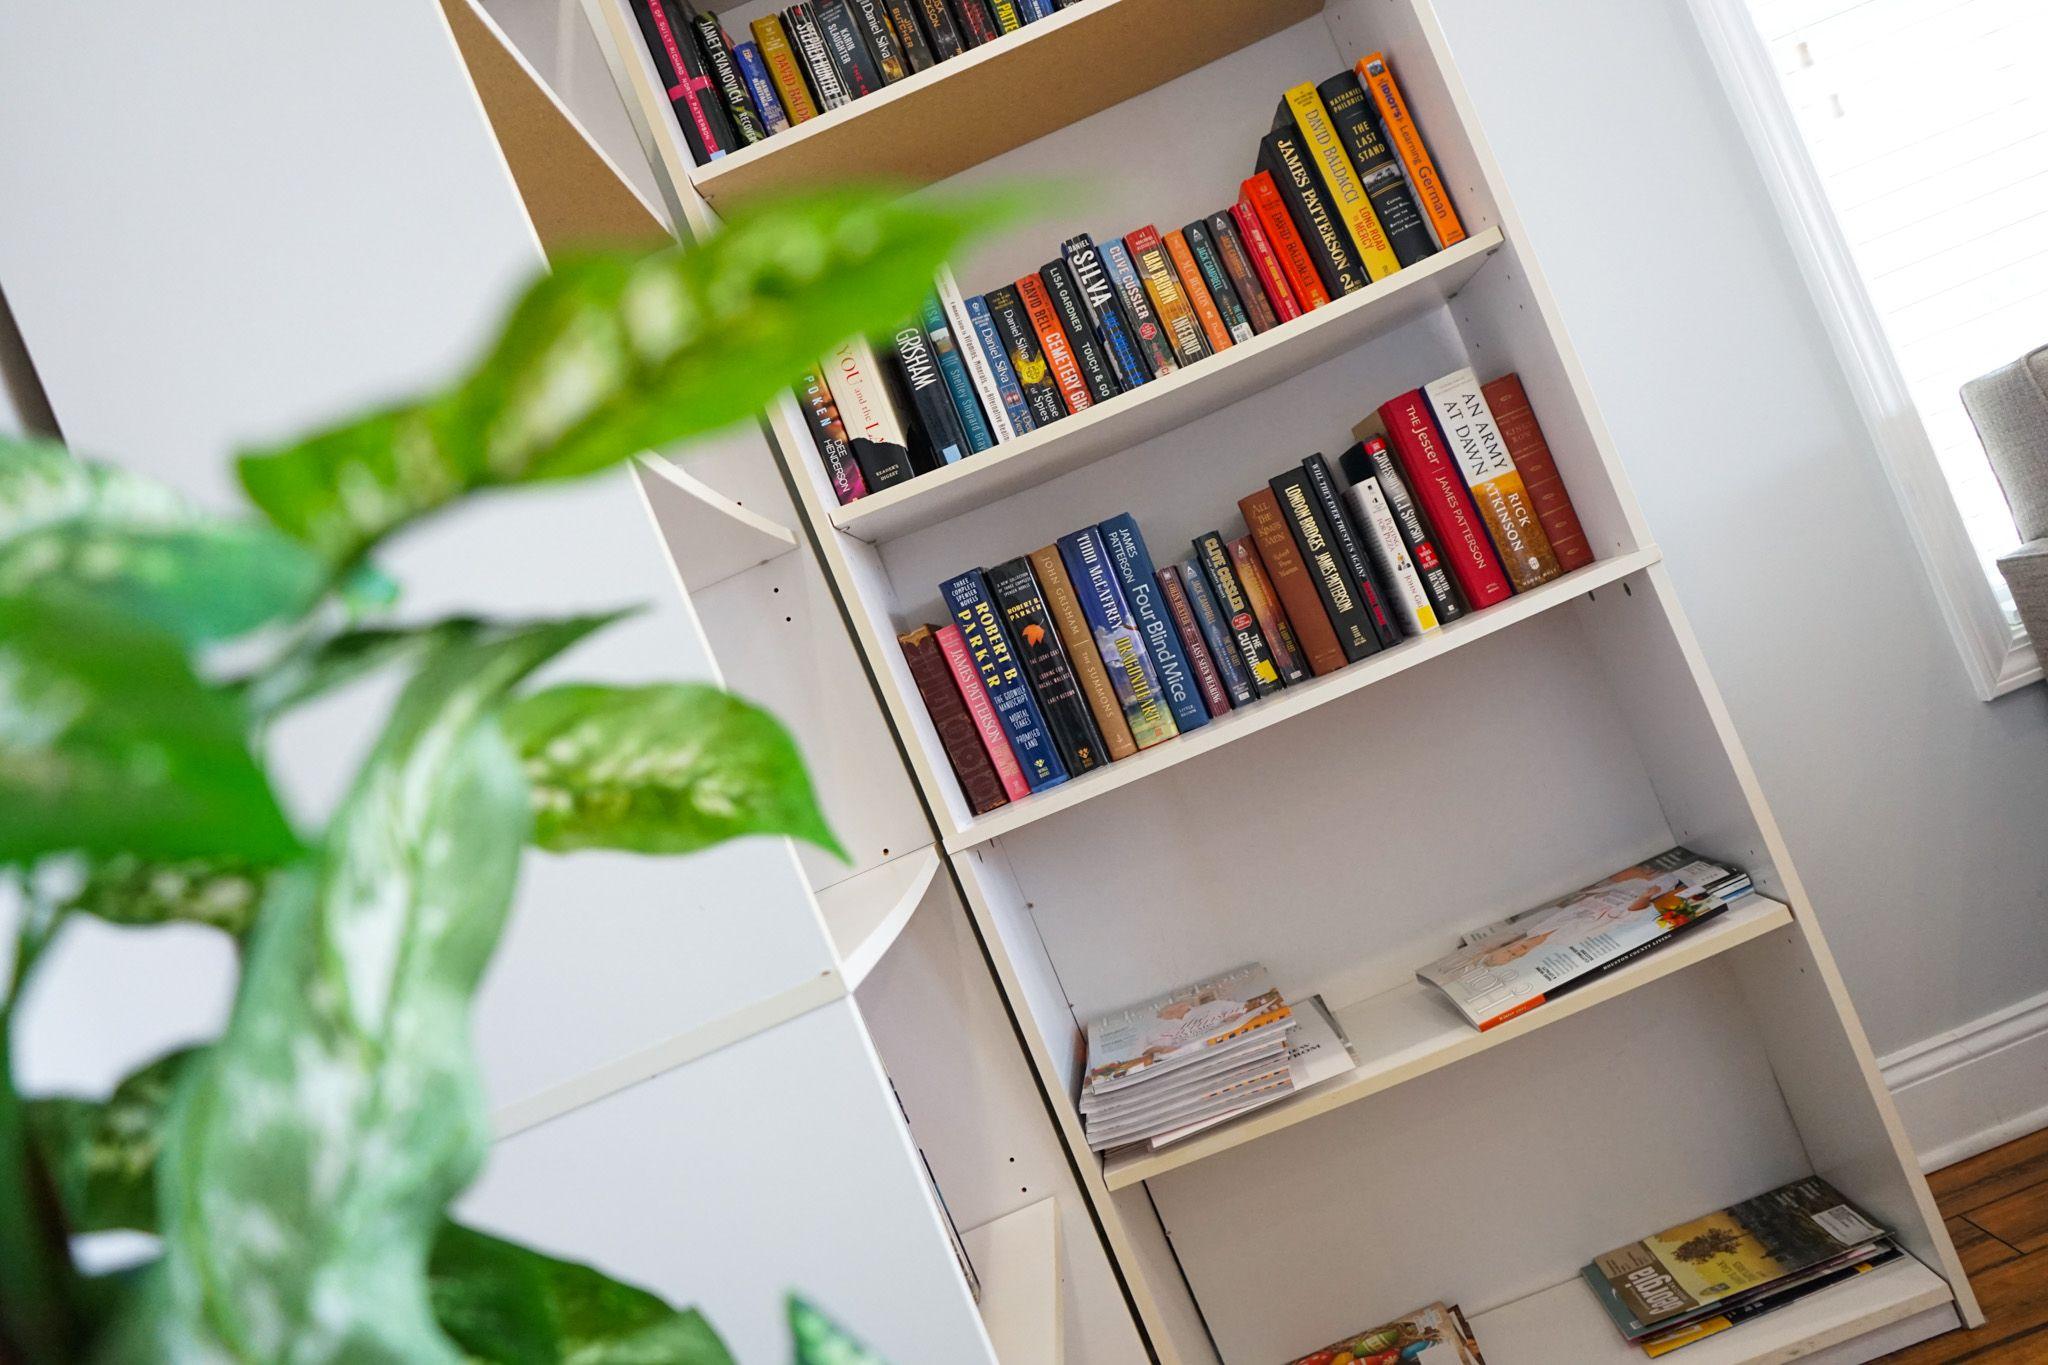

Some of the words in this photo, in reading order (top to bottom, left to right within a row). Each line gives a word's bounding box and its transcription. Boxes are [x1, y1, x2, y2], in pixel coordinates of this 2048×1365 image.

[861, 3, 882, 34] Daniel
[875, 35, 892, 58] Silva
[891, 7, 913, 48] BUTCHER
[903, 17, 914, 33] JIM
[996, 2, 1019, 32] PATTE
[796, 19, 828, 63] STEPHEN
[812, 59, 840, 97] HUNTER
[827, 23, 850, 64] SLAUGHTER
[840, 28, 854, 50] KARIN
[699, 19, 721, 50] JANET
[712, 51, 743, 104] EVANOVICH
[668, 46, 684, 75] RICHARD
[681, 77, 694, 99] NORTH
[690, 102, 710, 140] PATTERSON
[773, 51, 796, 86] DAVID
[789, 88, 812, 122] BALDA
[1352, 121, 1369, 134] THE
[1356, 133, 1376, 147] LAST
[1305, 109, 1330, 145] DAVID
[1322, 145, 1358, 204] BALDACCI
[1358, 143, 1385, 161] STAND
[1399, 125, 1421, 163] Learning
[1417, 165, 1449, 219] German
[1277, 137, 1309, 188] JAMES
[1303, 188, 1349, 270] PATTERSON
[1067, 239, 1089, 252] DANIEL
[1271, 212, 1290, 240] DAVID
[1287, 241, 1312, 286] BALDACCI
[1353, 221, 1373, 250] MERCY
[1359, 206, 1374, 228] LONG
[1370, 228, 1385, 251] ROAD
[1072, 249, 1112, 307] SILVA
[1142, 250, 1164, 272] DAN
[1197, 245, 1209, 261] JACK
[1204, 260, 1222, 291] CAMPBELL
[1110, 246, 1128, 274] CLIVE
[1122, 275, 1148, 319] CUSSLER
[1152, 270, 1178, 304] BROWN
[1189, 276, 1209, 308] BEATON
[1003, 309, 1020, 337] Daniel
[1016, 337, 1029, 358] Silva
[1022, 281, 1041, 308] DAVID
[1034, 309, 1051, 332] BELL
[1045, 331, 1080, 392] CEMETERY
[1070, 389, 1089, 411] GIR
[1050, 267, 1063, 288] LISA
[1059, 289, 1081, 331] GARDNER
[1081, 342, 1099, 372] TOUCH
[1099, 383, 1109, 396] GO
[1171, 314, 1200, 355] INFERNO
[894, 326, 936, 390] GRISHAM
[982, 328, 1000, 358] Daniel
[995, 360, 1010, 382] Silva
[803, 375, 831, 426] POKEN
[835, 345, 862, 386] YOU
[855, 387, 866, 404] and
[862, 406, 873, 420] the
[950, 368, 967, 398] Shelley
[961, 399, 980, 431] Shepard
[1042, 387, 1059, 417] House
[1034, 395, 1050, 421] Spies
[834, 439, 846, 456] DEE
[1444, 399, 1463, 421] AT
[1456, 425, 1486, 475] DAWN
[1462, 390, 1482, 417] AN
[1475, 420, 1506, 471] ARMY
[823, 439, 849, 492] HENDERSON
[1284, 484, 1309, 519] LONDON
[1405, 404, 1419, 426] THE
[1412, 424, 1439, 467] Jester
[1436, 475, 1457, 509] JAMES
[1453, 508, 1485, 569] PATTERSON
[1258, 512, 1272, 523] THE
[1312, 463, 1323, 479] WILL
[1319, 481, 1331, 499] THEY
[1328, 500, 1339, 519] EVER
[1336, 520, 1349, 541] TRUST
[1351, 553, 1365, 578] AGAIN?
[1400, 508, 1425, 544] SIMPSON
[1484, 480, 1522, 552] ATKINSON
[1508, 492, 1530, 527] RICK
[1119, 527, 1136, 557] JAMES
[1299, 516, 1325, 551] BRIDGES
[1377, 518, 1386, 531] FOR
[1383, 532, 1395, 552] PIZZA
[1384, 517, 1400, 546] PLAYING
[1109, 532, 1134, 583] PATTERSON
[1204, 538, 1225, 568] CLIVE
[1217, 566, 1244, 612] CUSSLER
[1314, 551, 1336, 576] JAMES
[951, 582, 976, 596] COMPLETE
[953, 578, 968, 587] THREE
[956, 589, 977, 601] SPENSER
[959, 595, 978, 606] NOVELS
[1192, 579, 1203, 595] JACK
[1198, 595, 1215, 624] CAMPBELL
[1210, 567, 1219, 583] Justin
[1216, 584, 1225, 598] Scott
[1324, 572, 1352, 613] PATTERSON
[1405, 575, 1417, 594] JOHN
[1007, 600, 1032, 613] ROBERT
[1009, 604, 1041, 620] PARKER
[958, 608, 999, 688] PARKER
[975, 601, 1010, 665] ROBERT
[1003, 668, 1019, 684] B.
[1042, 556, 1058, 584] JOHN
[1055, 587, 1079, 634] GRISHAM
[1081, 652, 1090, 663] THE
[1088, 667, 1113, 718] SUMMONS
[1076, 533, 1097, 563] TODD
[1088, 565, 1122, 629] McCAFFREY
[1115, 636, 1160, 723] DRAGONHEART
[1132, 583, 1158, 622] Four
[1147, 621, 1174, 662] Blind
[1162, 662, 1190, 702] Mice
[1251, 634, 1261, 648] THE
[1192, 643, 1202, 658] LAST
[1198, 659, 1209, 674] SEEN
[1204, 675, 1220, 703] WEARING
[950, 648, 972, 682] JAMES
[966, 681, 1000, 744] PATTERSON
[998, 694, 1027, 711] MANUSCRIPT
[1009, 709, 1028, 722] MORTAL
[1014, 717, 1030, 728] STAKES
[1016, 728, 1040, 743] PROMISED
[1025, 739, 1037, 748] LAND
